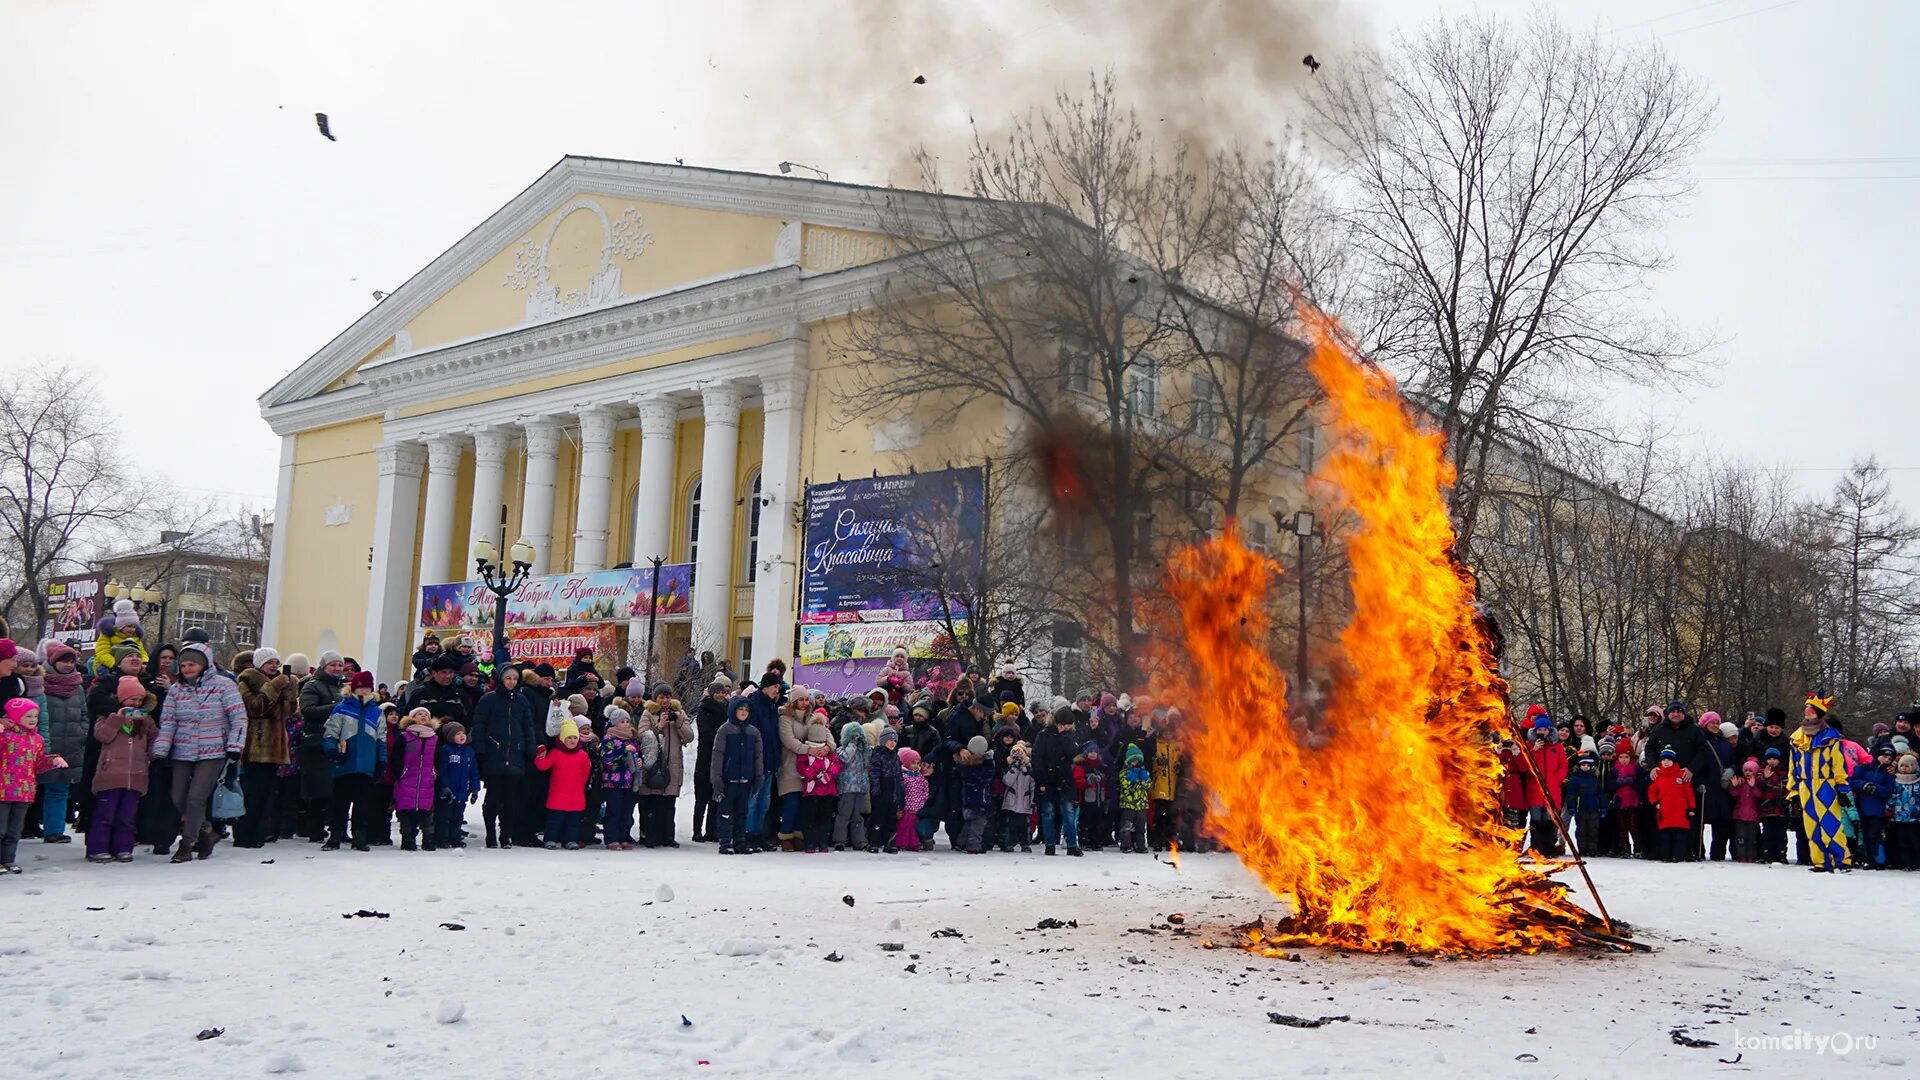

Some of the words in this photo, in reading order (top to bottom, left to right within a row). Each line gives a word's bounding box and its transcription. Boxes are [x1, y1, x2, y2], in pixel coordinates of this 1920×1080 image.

[806, 533, 894, 574] Красавица
[514, 583, 558, 608] Добра!
[560, 577, 632, 606] Красоты!
[852, 625, 892, 636] ИГРОВАЯ
[861, 636, 882, 647] ДЛЯ
[884, 635, 917, 647] ДЕТЕЙ
